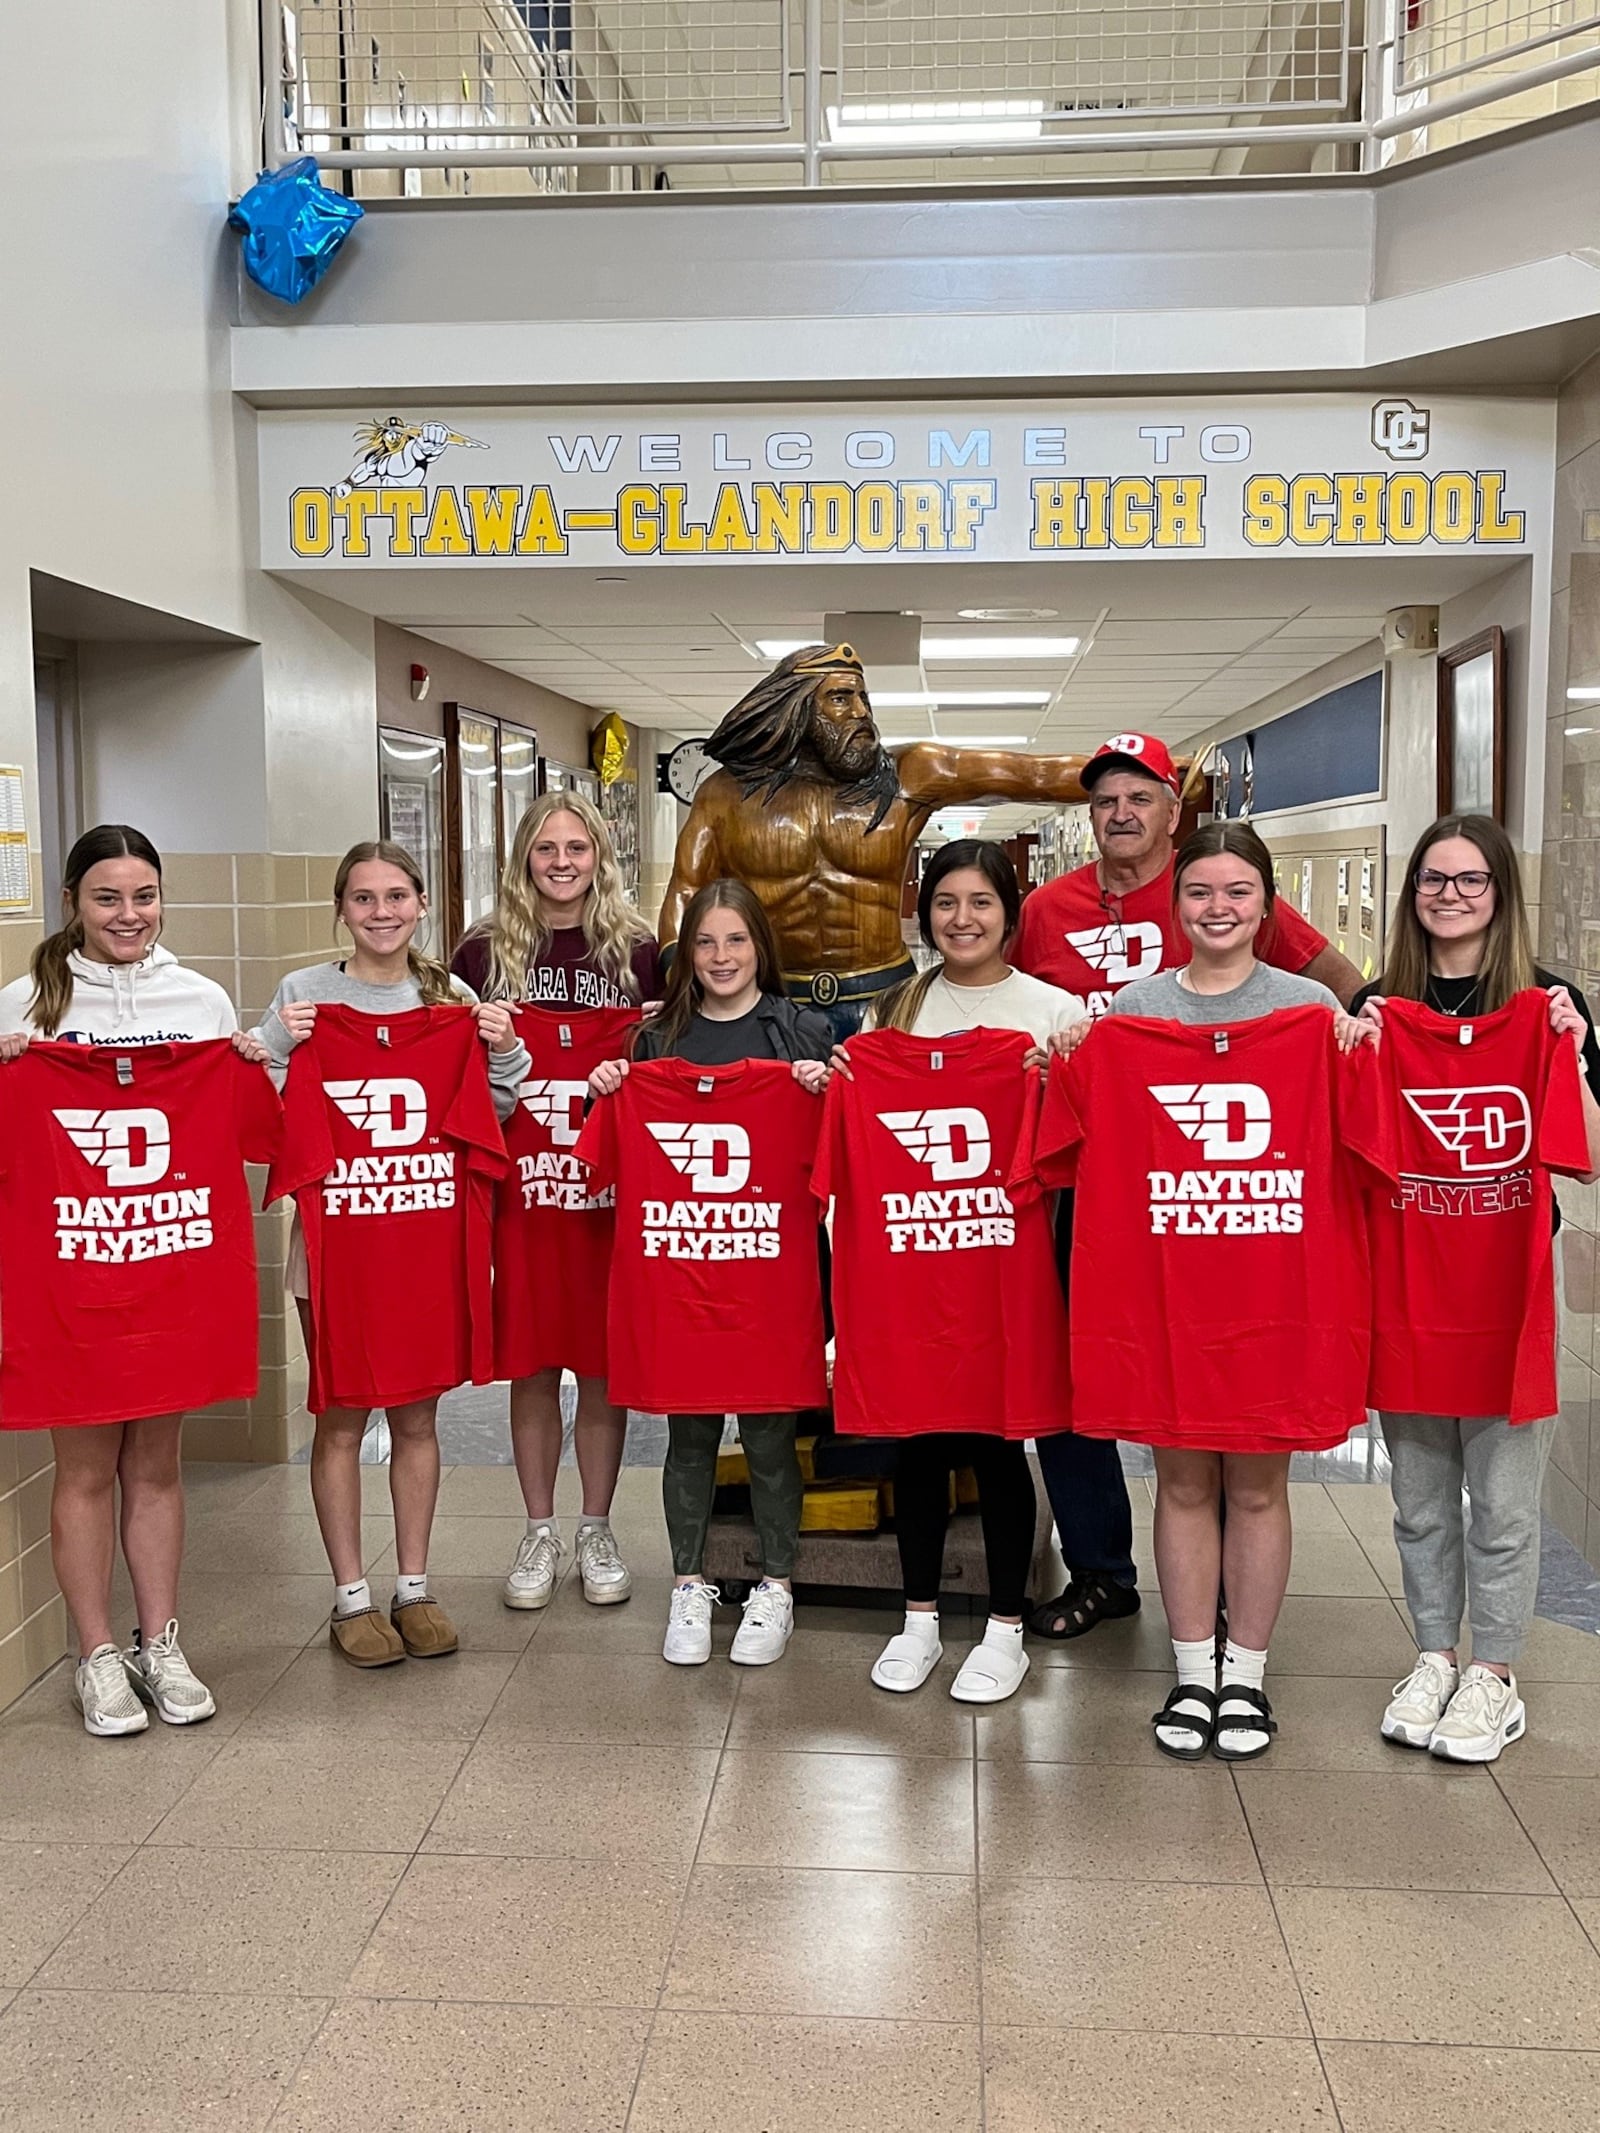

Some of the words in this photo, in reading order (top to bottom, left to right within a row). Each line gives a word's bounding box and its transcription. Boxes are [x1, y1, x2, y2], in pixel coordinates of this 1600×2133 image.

[547, 426, 1067, 473] WELCOME
[1138, 424, 1251, 464] TO
[1030, 474, 1207, 552] HIGH
[1243, 469, 1526, 547] SCHOOL
[56, 1030, 193, 1046] Champion
[323, 1151, 456, 1185] DAYTON
[516, 1151, 591, 1181] DAYT
[321, 1180, 456, 1217] FLYERS
[1146, 1168, 1305, 1201] DAYTON
[52, 1186, 212, 1228] DAYTON
[640, 1199, 783, 1230] DAYTON
[1148, 1202, 1305, 1236] FLYERS
[54, 1218, 214, 1264] FLYERS
[641, 1229, 781, 1262] FLYERS
[884, 1216, 1016, 1253] FLYERS
